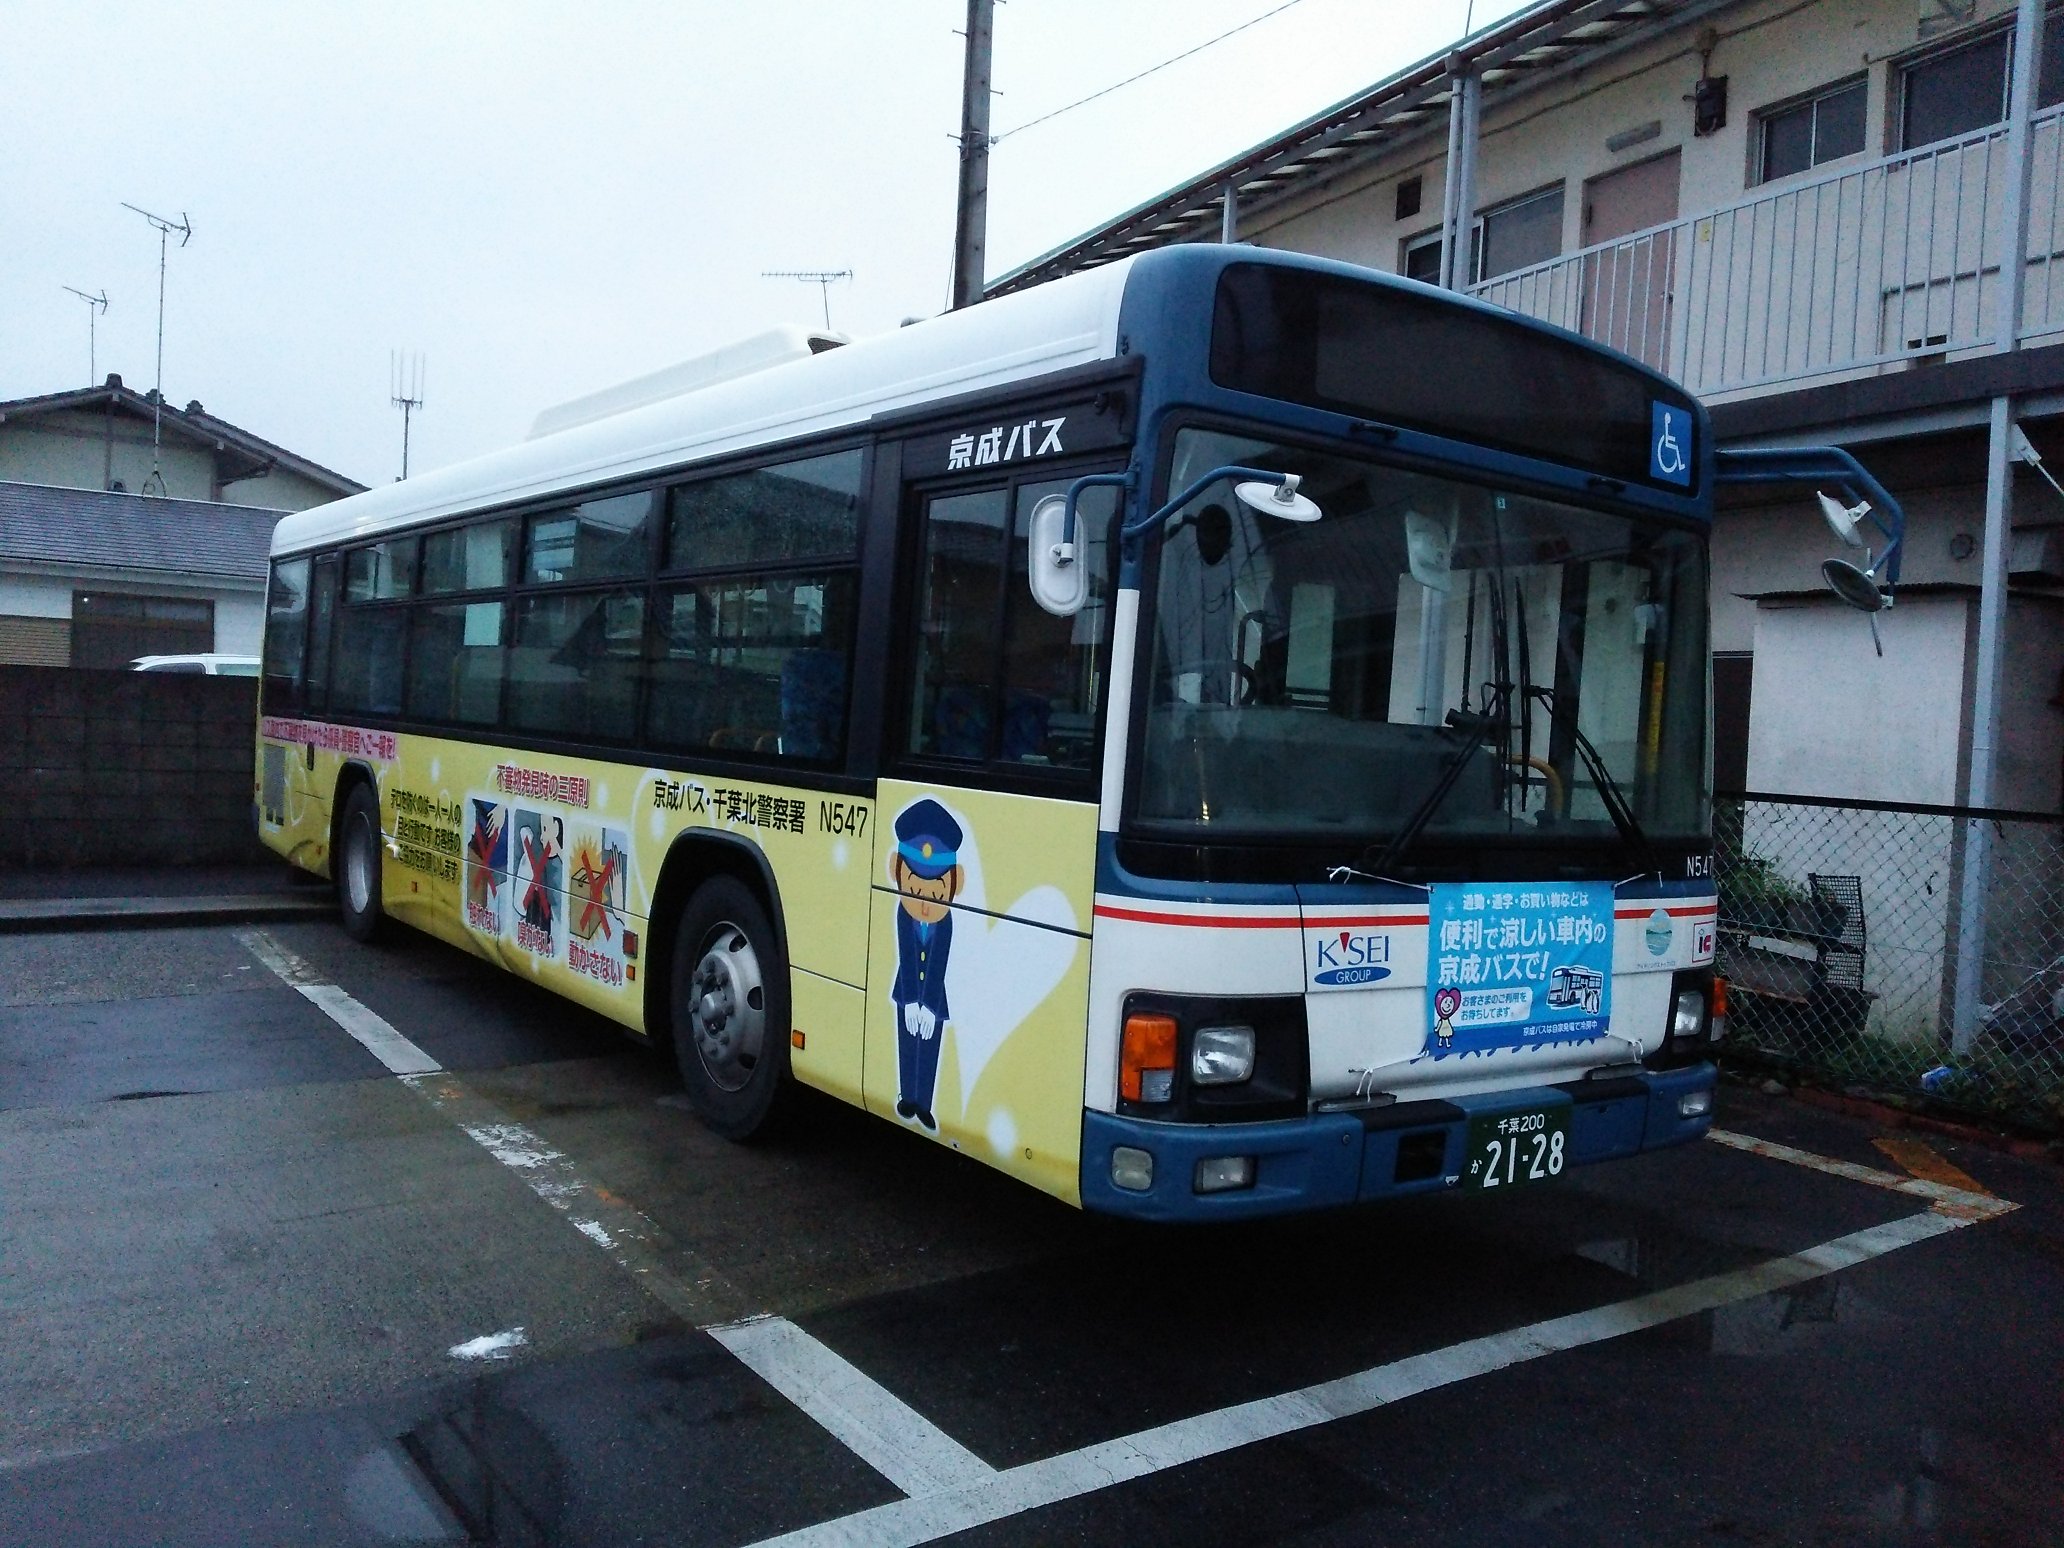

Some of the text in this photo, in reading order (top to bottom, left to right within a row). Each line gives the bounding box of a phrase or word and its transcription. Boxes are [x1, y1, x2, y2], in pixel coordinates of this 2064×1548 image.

[947, 417, 1067, 471] 京成バス
[497, 764, 590, 809] 不審物発見時の三原則
[653, 778, 868, 838] 京成バス・千葉北警察署 N547
[1686, 855, 1715, 877] N547
[1462, 891, 1589, 911] 通勤・通学・お買い物などは
[1440, 914, 1607, 952] 便利で涼しい車内の
[569, 939, 623, 986] 動かさない
[1336, 969, 1372, 984] GROUP
[1438, 950, 1550, 986] 京成バスで!
[1461, 991, 1527, 1008] お客さまのご利用を
[1498, 1113, 1545, 1135] 千葉200
[1470, 1130, 1565, 1188] か 21-28
